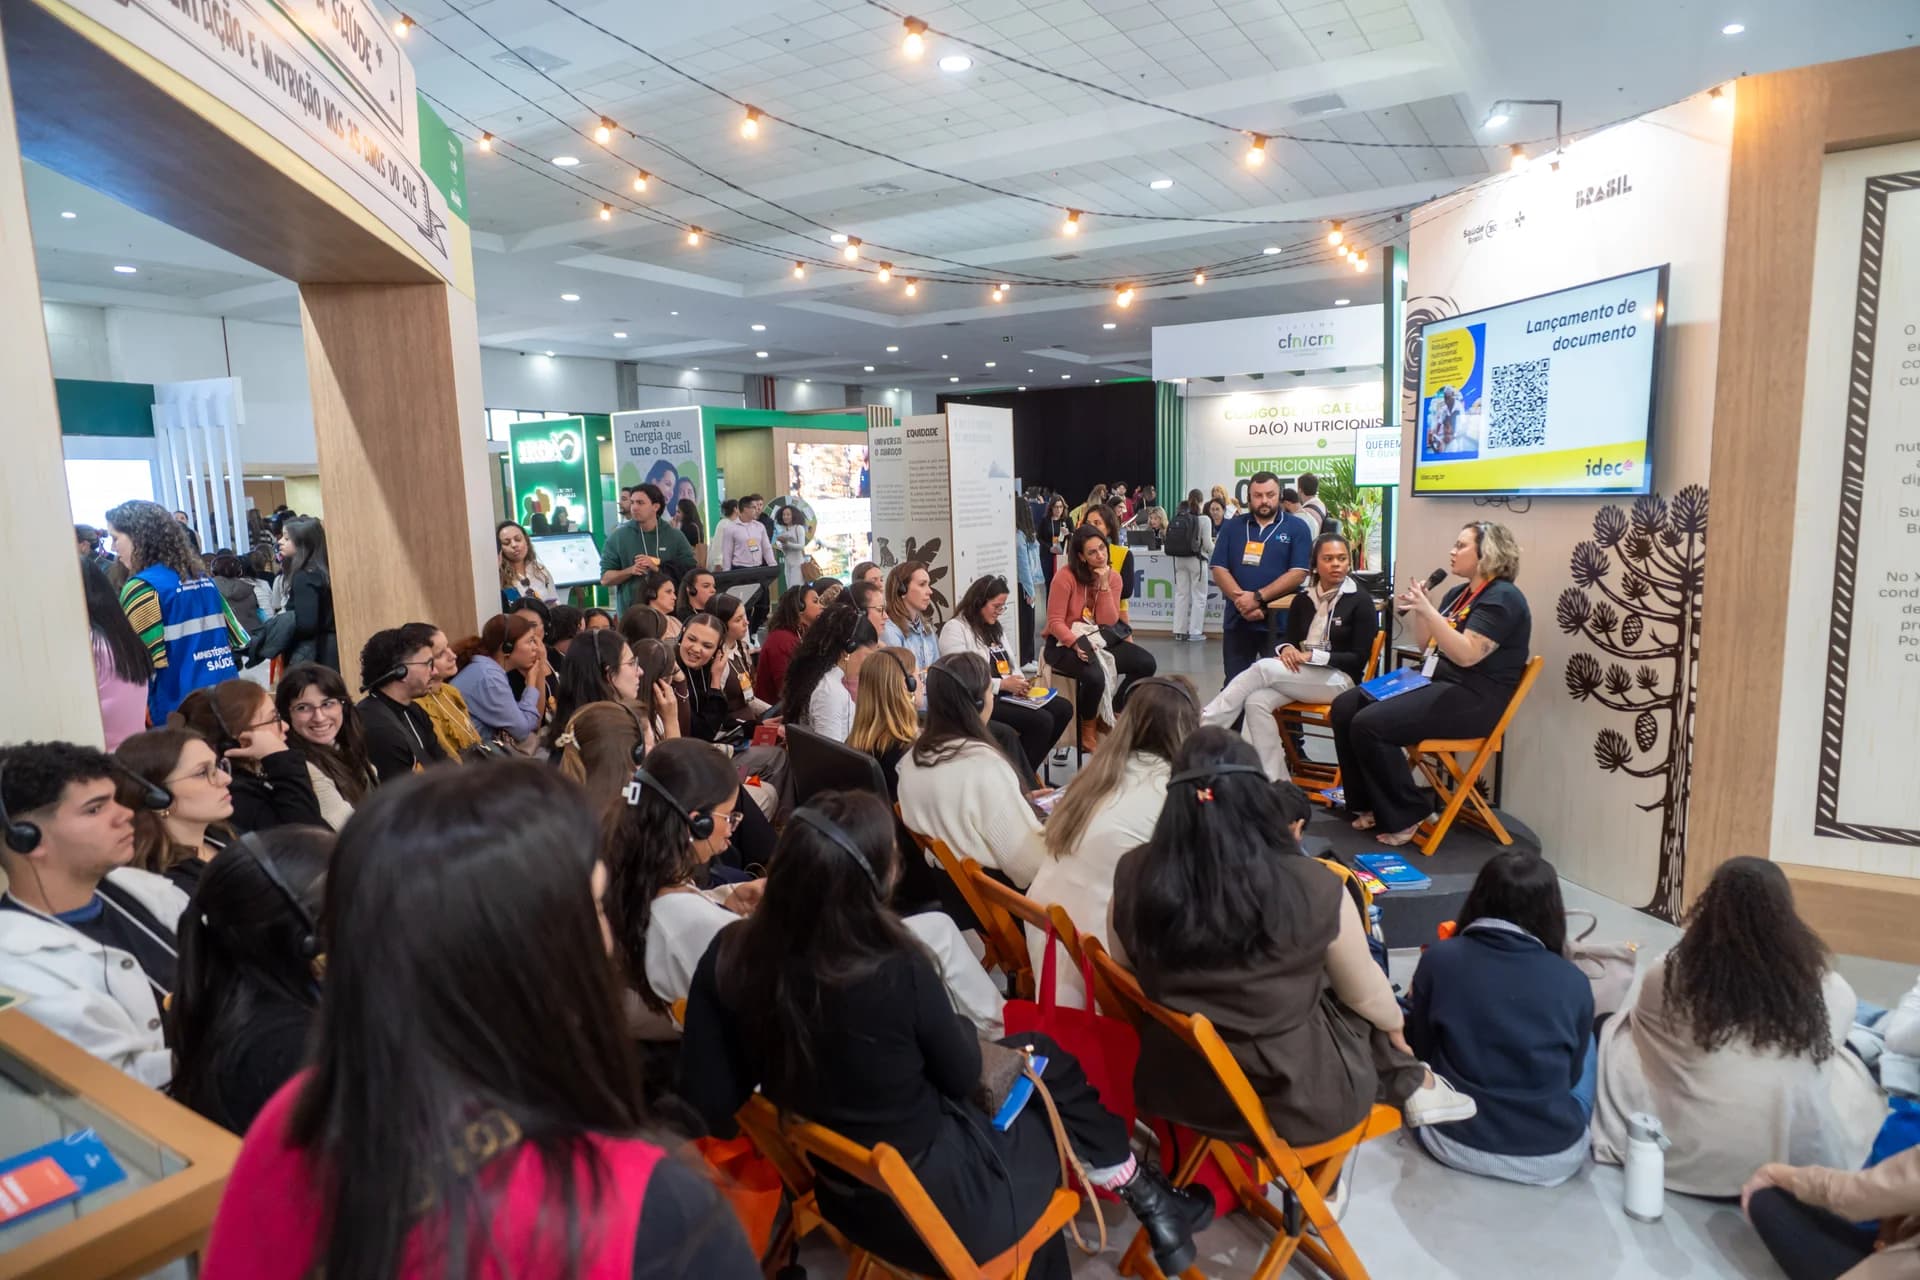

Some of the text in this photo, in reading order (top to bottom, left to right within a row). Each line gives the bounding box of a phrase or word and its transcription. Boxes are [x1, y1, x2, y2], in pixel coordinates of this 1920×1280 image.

[332, 0, 372, 74] SAÚDE
[247, 31, 258, 69] E
[261, 40, 321, 121] NUTRIÇÃO
[323, 96, 344, 139] NOS
[362, 135, 386, 178] ANOS
[387, 159, 400, 192] DO
[402, 174, 417, 208] SUS
[1576, 174, 1632, 208] BRASIL
[1526, 298, 1637, 334] Lançamento de
[1552, 324, 1637, 351] documento
[640, 420, 660, 428] Arroz
[1249, 421, 1288, 435] DA(O)
[624, 428, 682, 444] Energia que
[630, 446, 651, 456] une
[653, 447, 659, 455] o
[1585, 458, 1623, 477] idec
[1887, 572, 1909, 582] No
